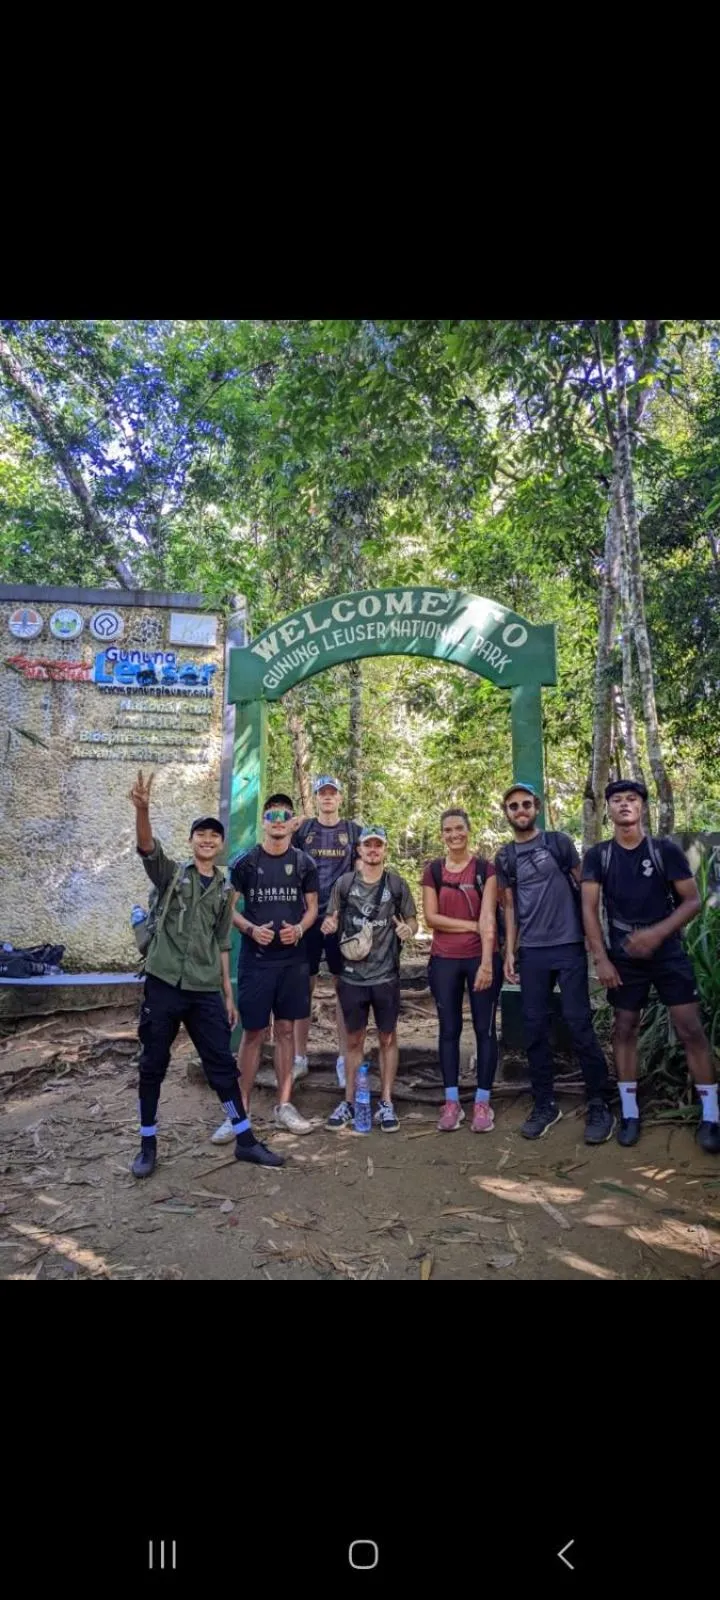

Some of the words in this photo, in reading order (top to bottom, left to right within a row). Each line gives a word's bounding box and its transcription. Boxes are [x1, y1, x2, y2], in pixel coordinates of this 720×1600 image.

[251, 592, 450, 663] WELCOME
[95, 652, 217, 686] Leuser
[263, 641, 320, 689] GUNUNG
[322, 622, 385, 651] LEUSER
[390, 620, 465, 647] NATIONAL
[471, 636, 512, 673] PARK
[250, 887, 297, 896] BAHRAIN
